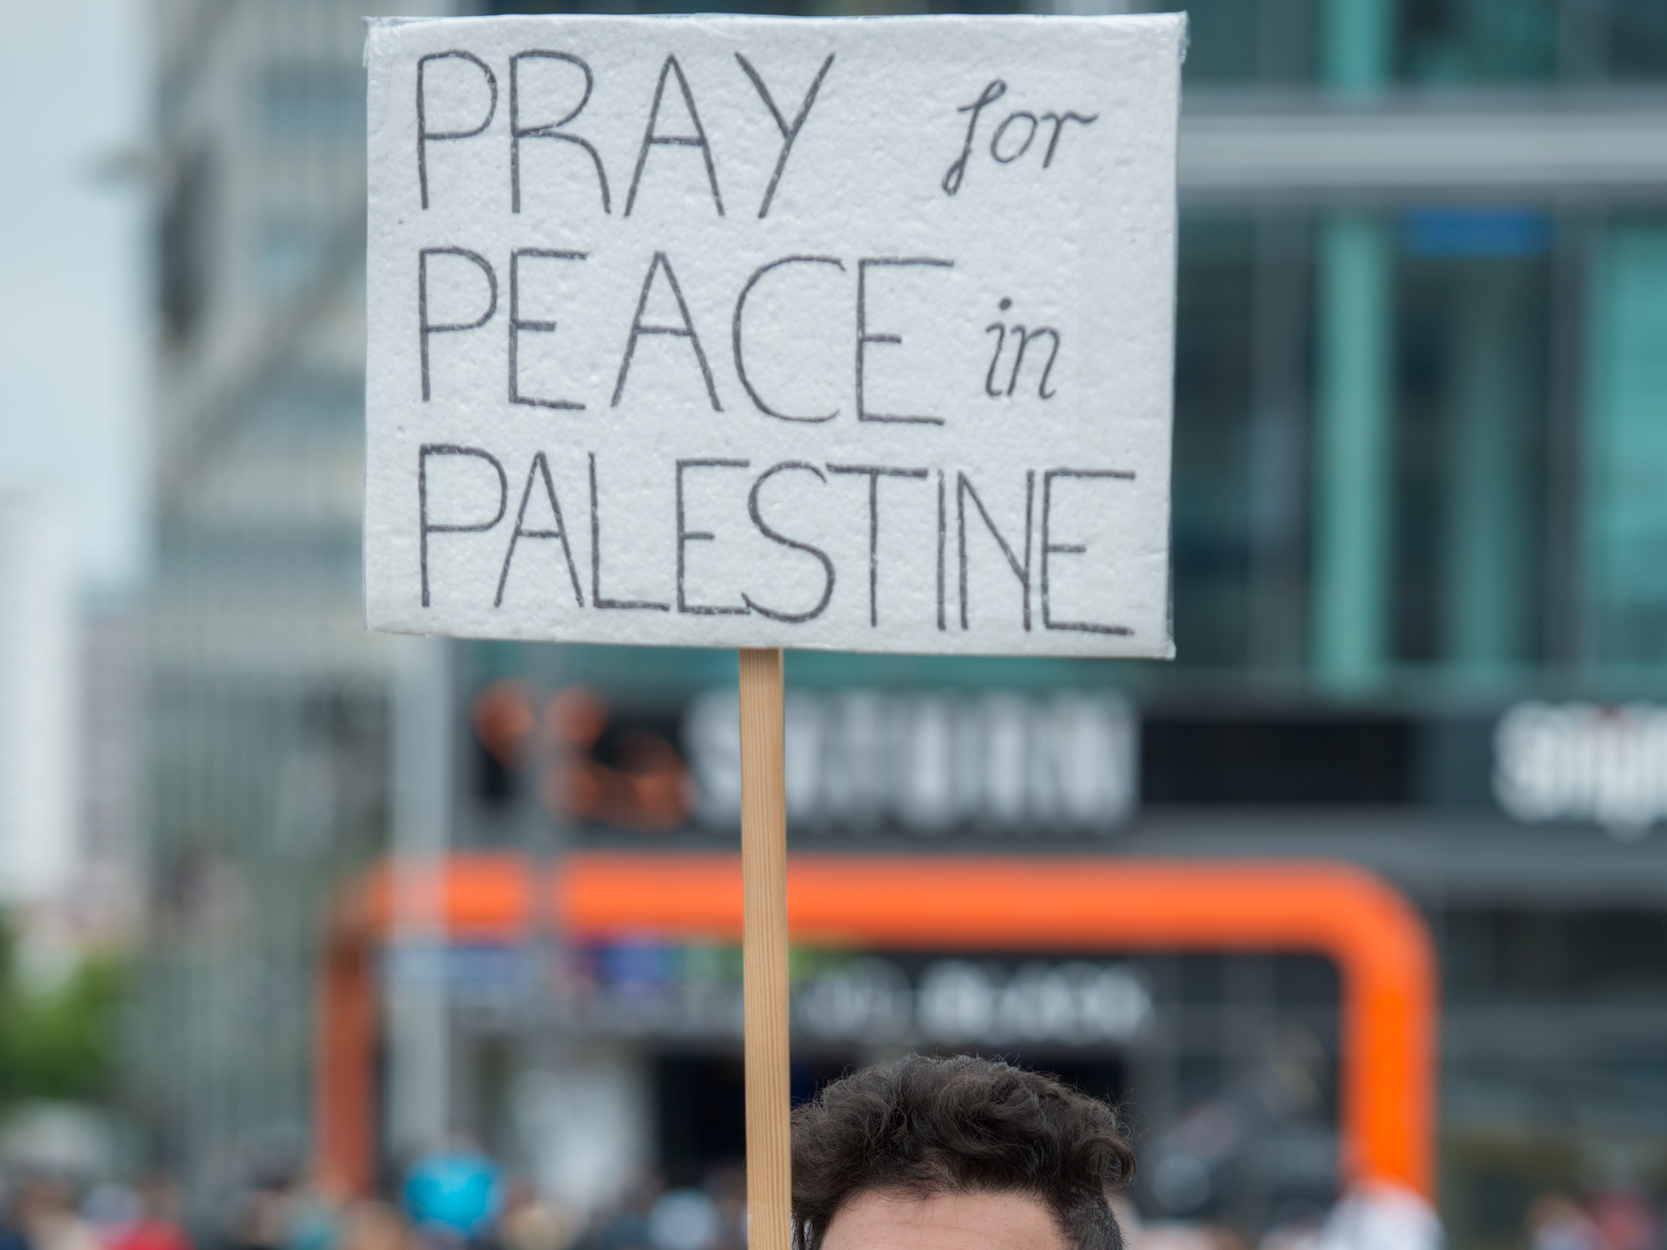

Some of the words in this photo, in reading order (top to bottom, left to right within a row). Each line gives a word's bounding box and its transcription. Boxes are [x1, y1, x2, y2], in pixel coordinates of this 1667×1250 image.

[416, 50, 835, 219] PRAY
[942, 80, 1098, 196] for
[419, 246, 954, 426] PEACE
[986, 298, 1060, 400] in
[418, 444, 1135, 635] PALESTINE
